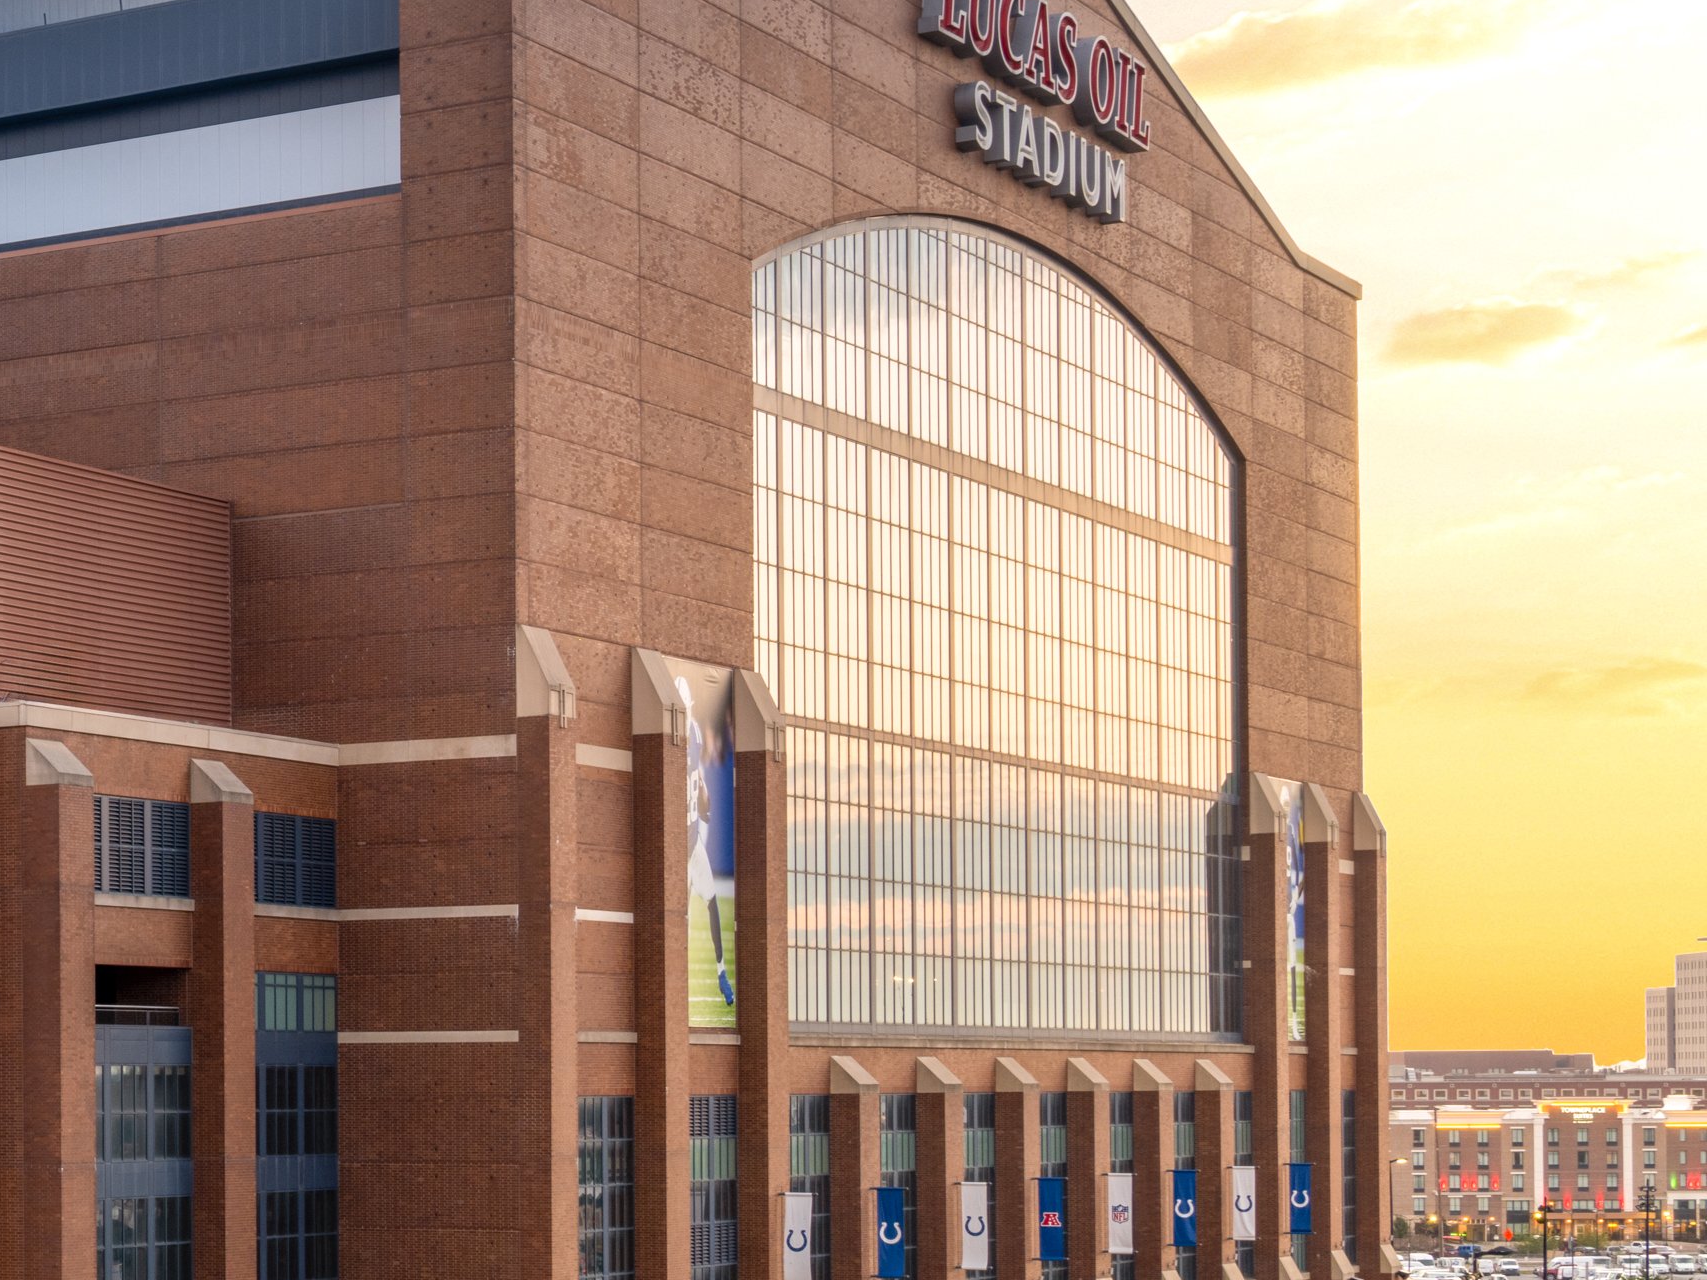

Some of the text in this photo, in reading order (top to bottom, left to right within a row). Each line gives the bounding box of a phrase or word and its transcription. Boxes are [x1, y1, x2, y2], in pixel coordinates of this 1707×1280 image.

[967, 79, 1126, 224] STADIUM
[1085, 34, 1151, 152] OIL
[1113, 1212, 1127, 1222] NFL
